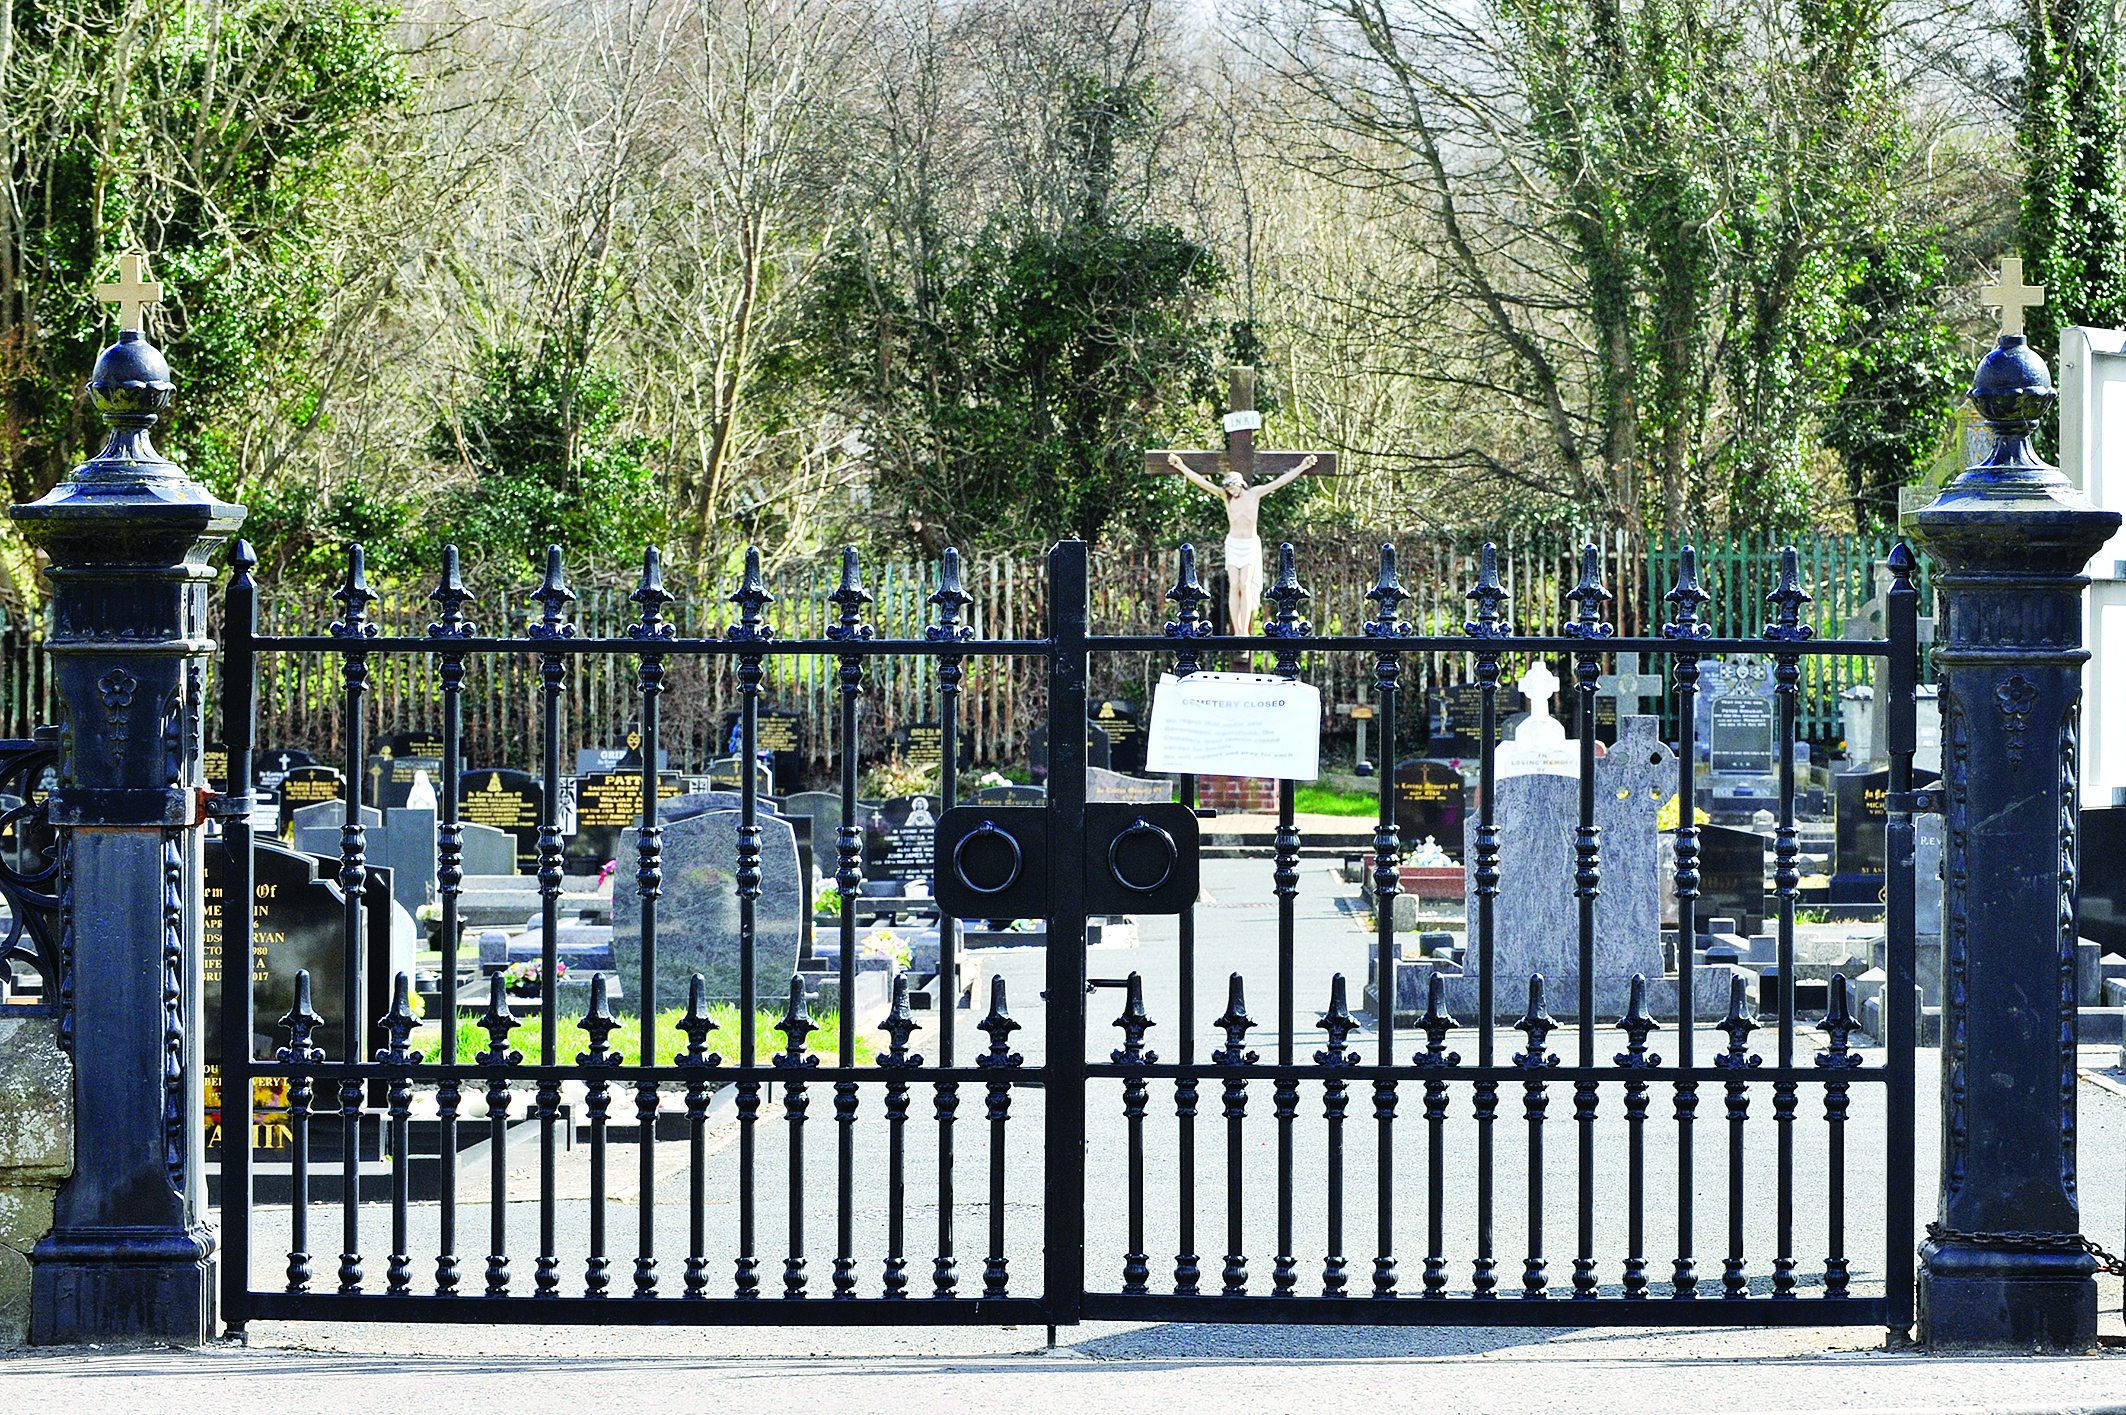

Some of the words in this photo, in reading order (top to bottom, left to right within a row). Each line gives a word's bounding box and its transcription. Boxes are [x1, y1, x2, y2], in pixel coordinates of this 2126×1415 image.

[1230, 416, 1254, 428] INRI
[1182, 698, 1239, 708] CEMETERY
[1244, 700, 1286, 708] CLOSED
[256, 884, 277, 898] Of
